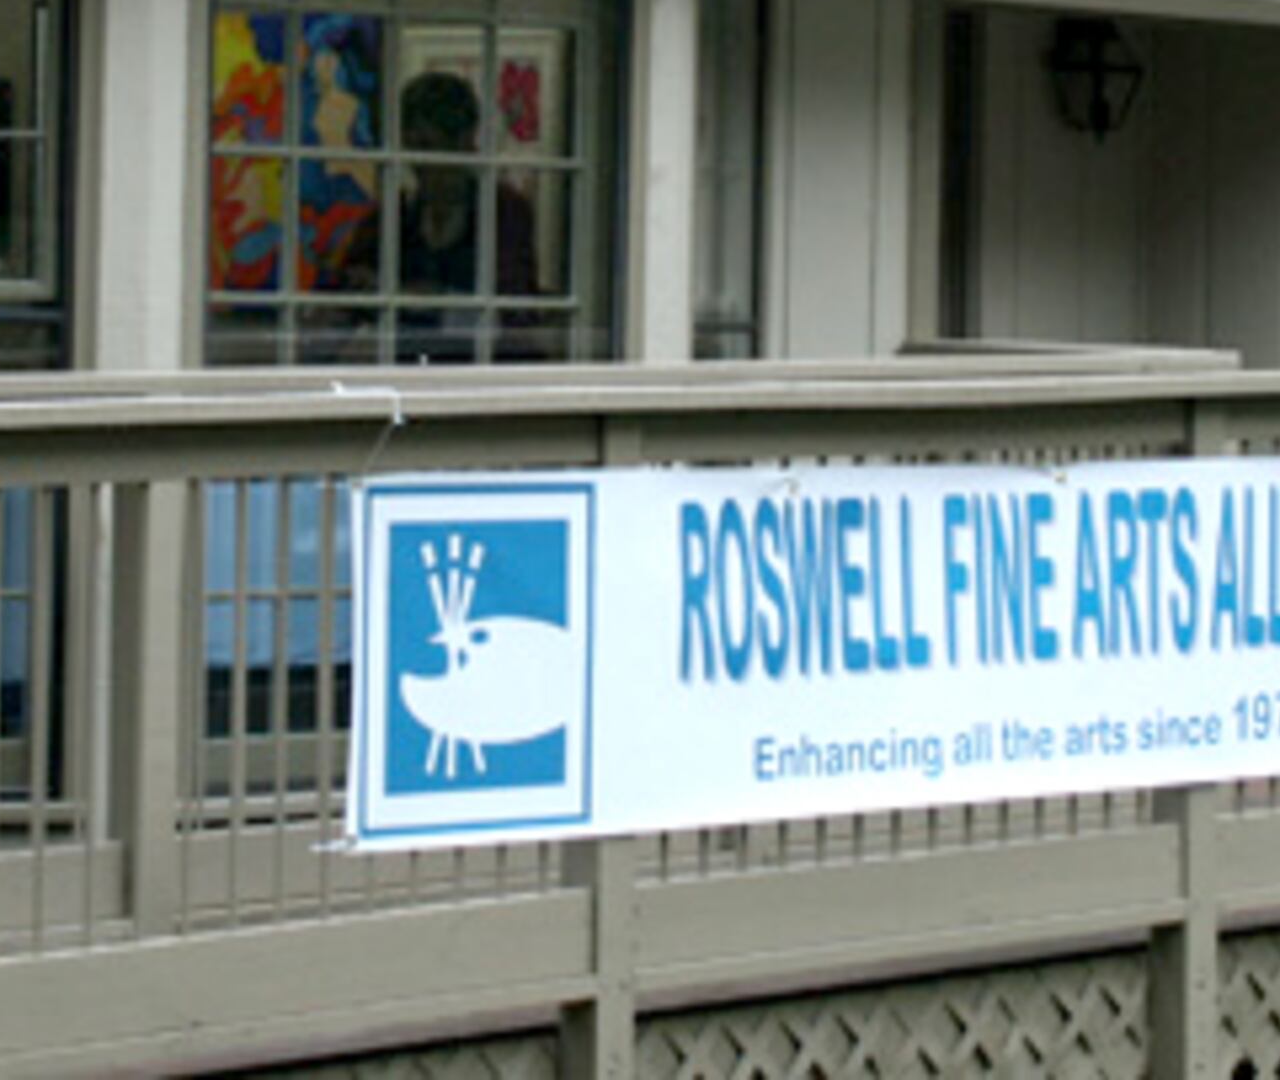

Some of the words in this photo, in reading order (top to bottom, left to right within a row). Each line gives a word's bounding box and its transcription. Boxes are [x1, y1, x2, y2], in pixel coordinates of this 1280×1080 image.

[678, 494, 931, 684] ROSWELL
[943, 491, 1060, 666] FINE
[1072, 486, 1200, 656] ARTS
[753, 736, 943, 781] Enhancing
[954, 724, 992, 764] all
[1002, 721, 1054, 760] the
[1066, 716, 1127, 756] arts
[1139, 711, 1222, 751] since
